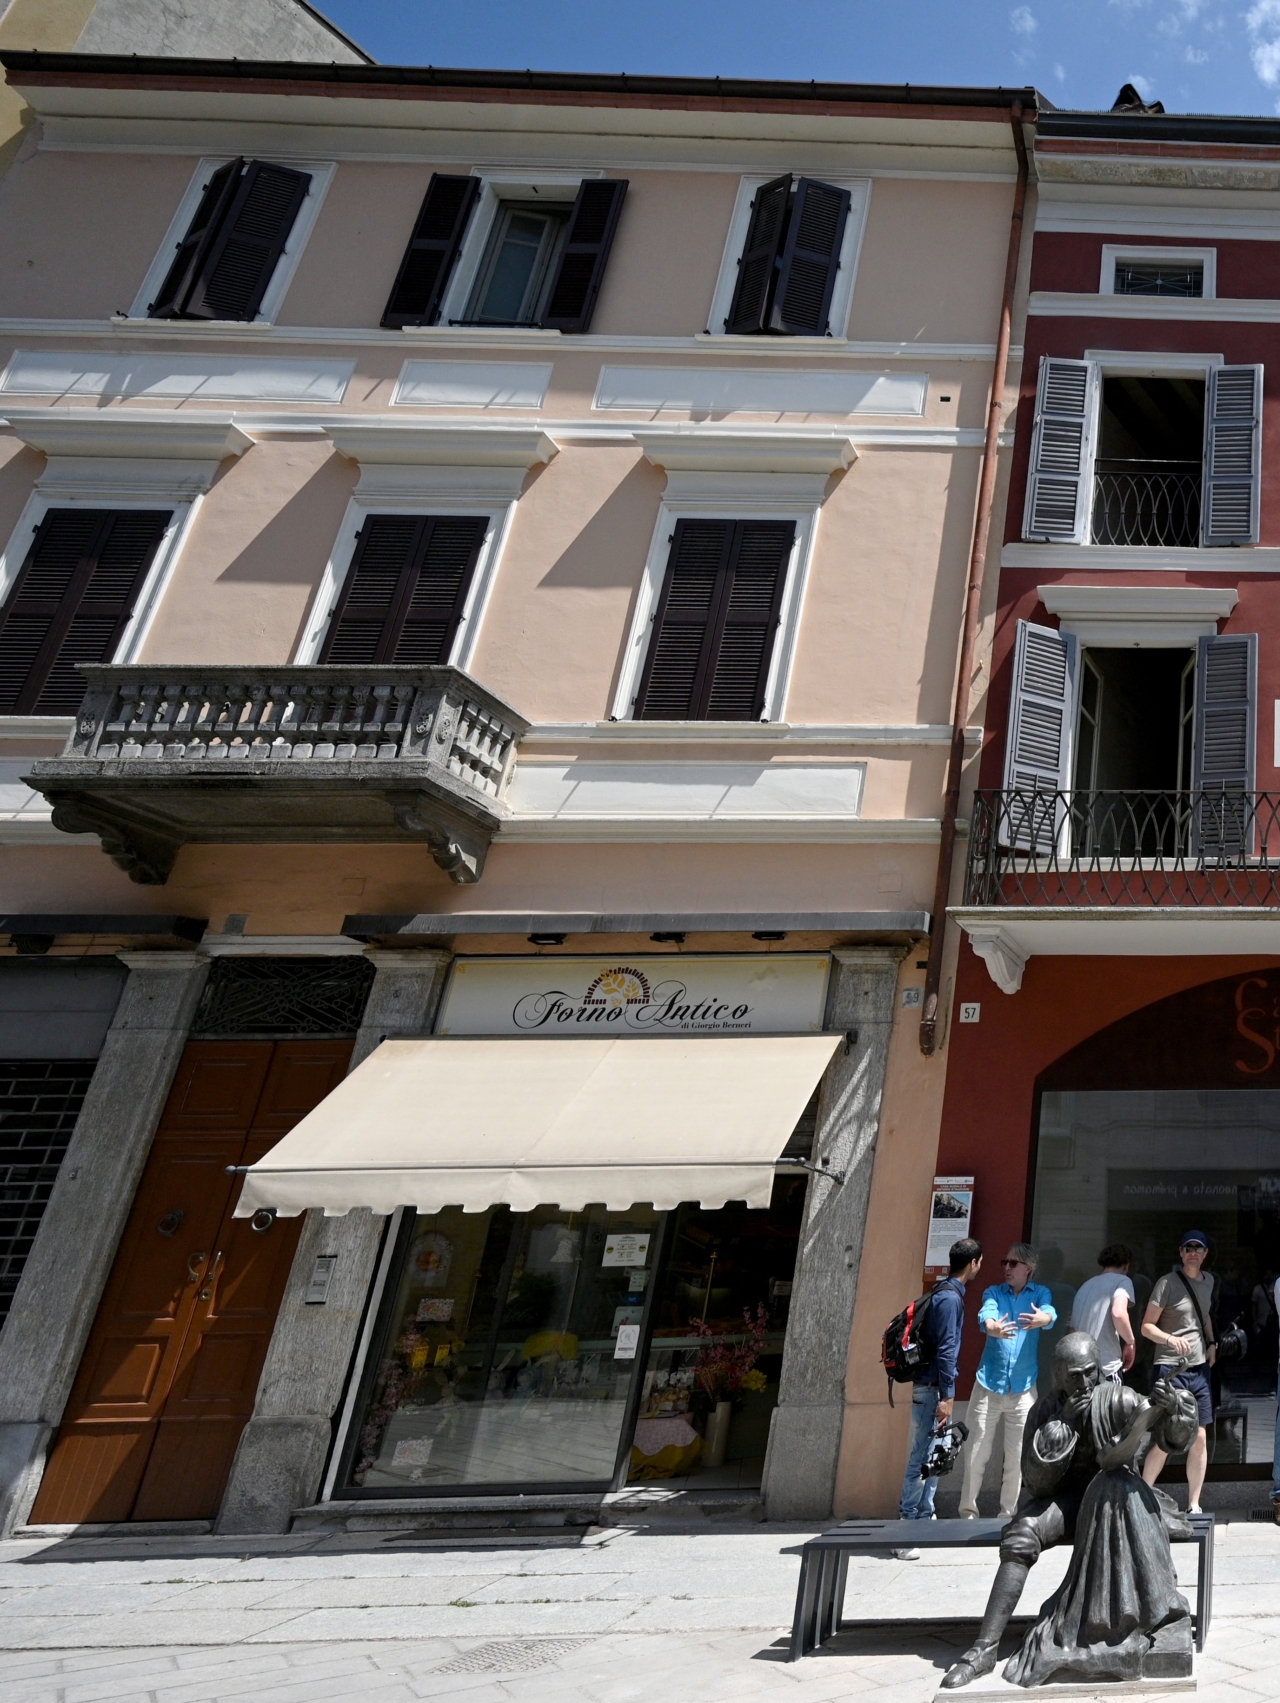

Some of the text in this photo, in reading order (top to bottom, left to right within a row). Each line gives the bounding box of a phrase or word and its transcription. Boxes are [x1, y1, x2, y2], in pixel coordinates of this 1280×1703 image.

[512, 980, 754, 1030] Forno Antico
[964, 1007, 977, 1019] 57
[681, 1021, 752, 1031] di Giorgio Berneri
